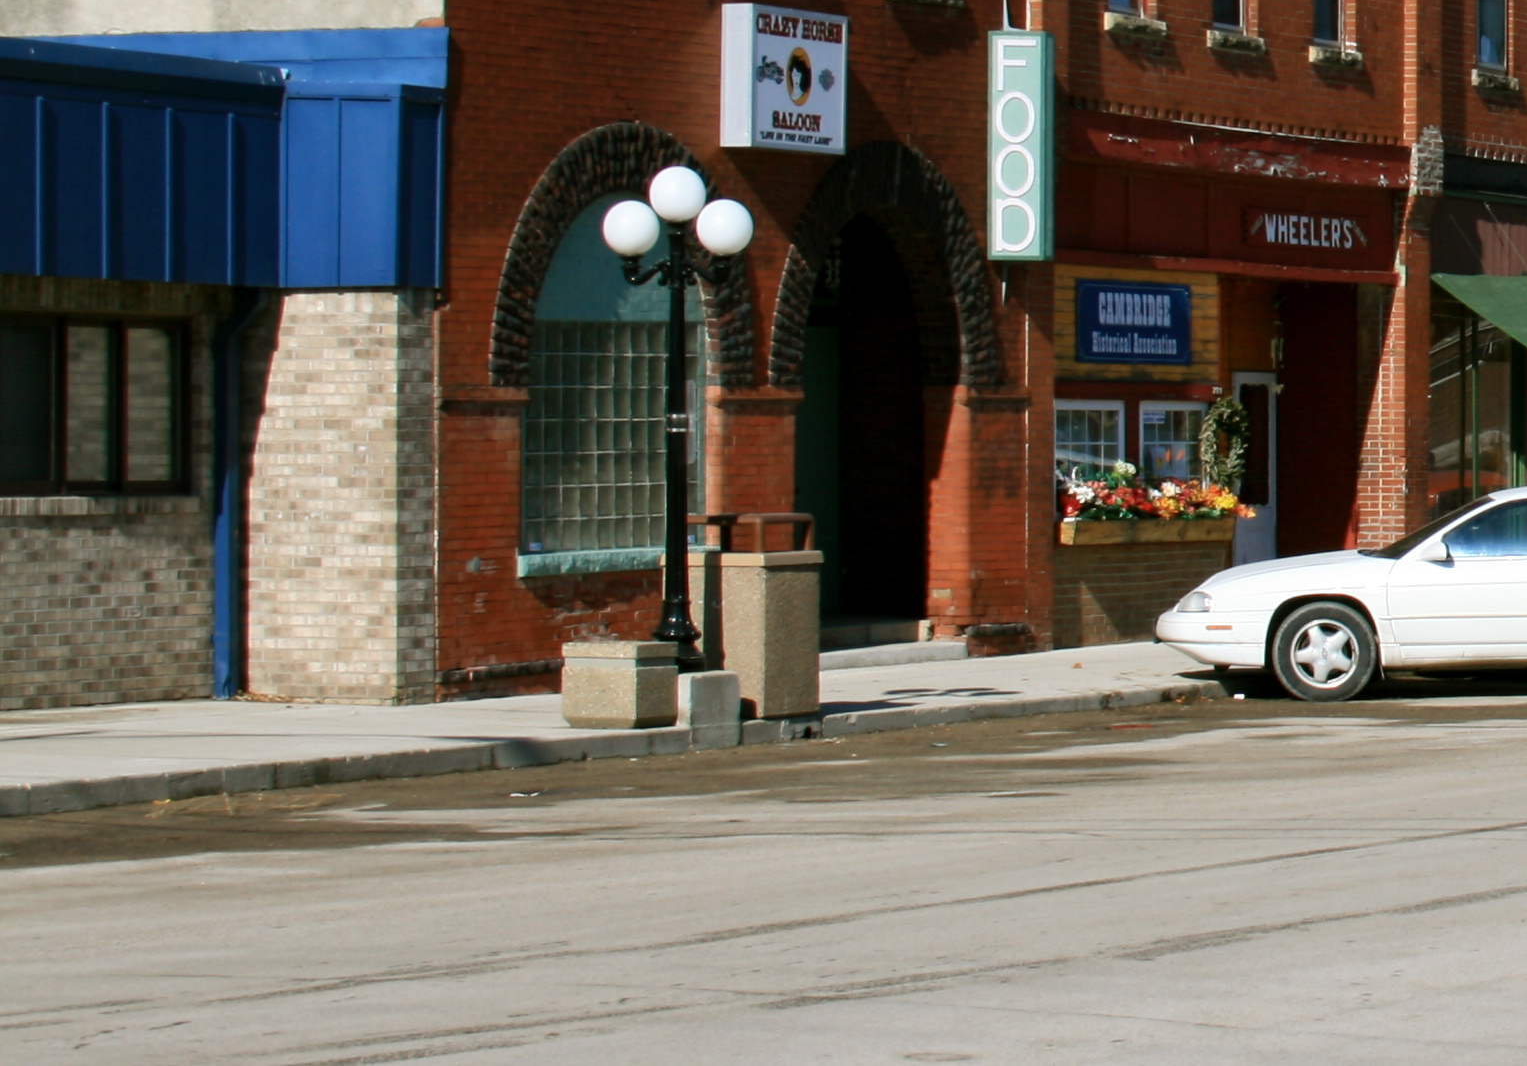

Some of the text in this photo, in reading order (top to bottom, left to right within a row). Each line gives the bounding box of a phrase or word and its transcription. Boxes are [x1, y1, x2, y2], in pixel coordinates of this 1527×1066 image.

[757, 13, 843, 44] CRAZY HORSE
[772, 109, 821, 133] SALOON
[994, 38, 1038, 253] FOOD
[1264, 213, 1353, 249] WHEELER'S
[1098, 291, 1171, 327] CAMBRIDGE
[1092, 330, 1177, 355] Historical Association
